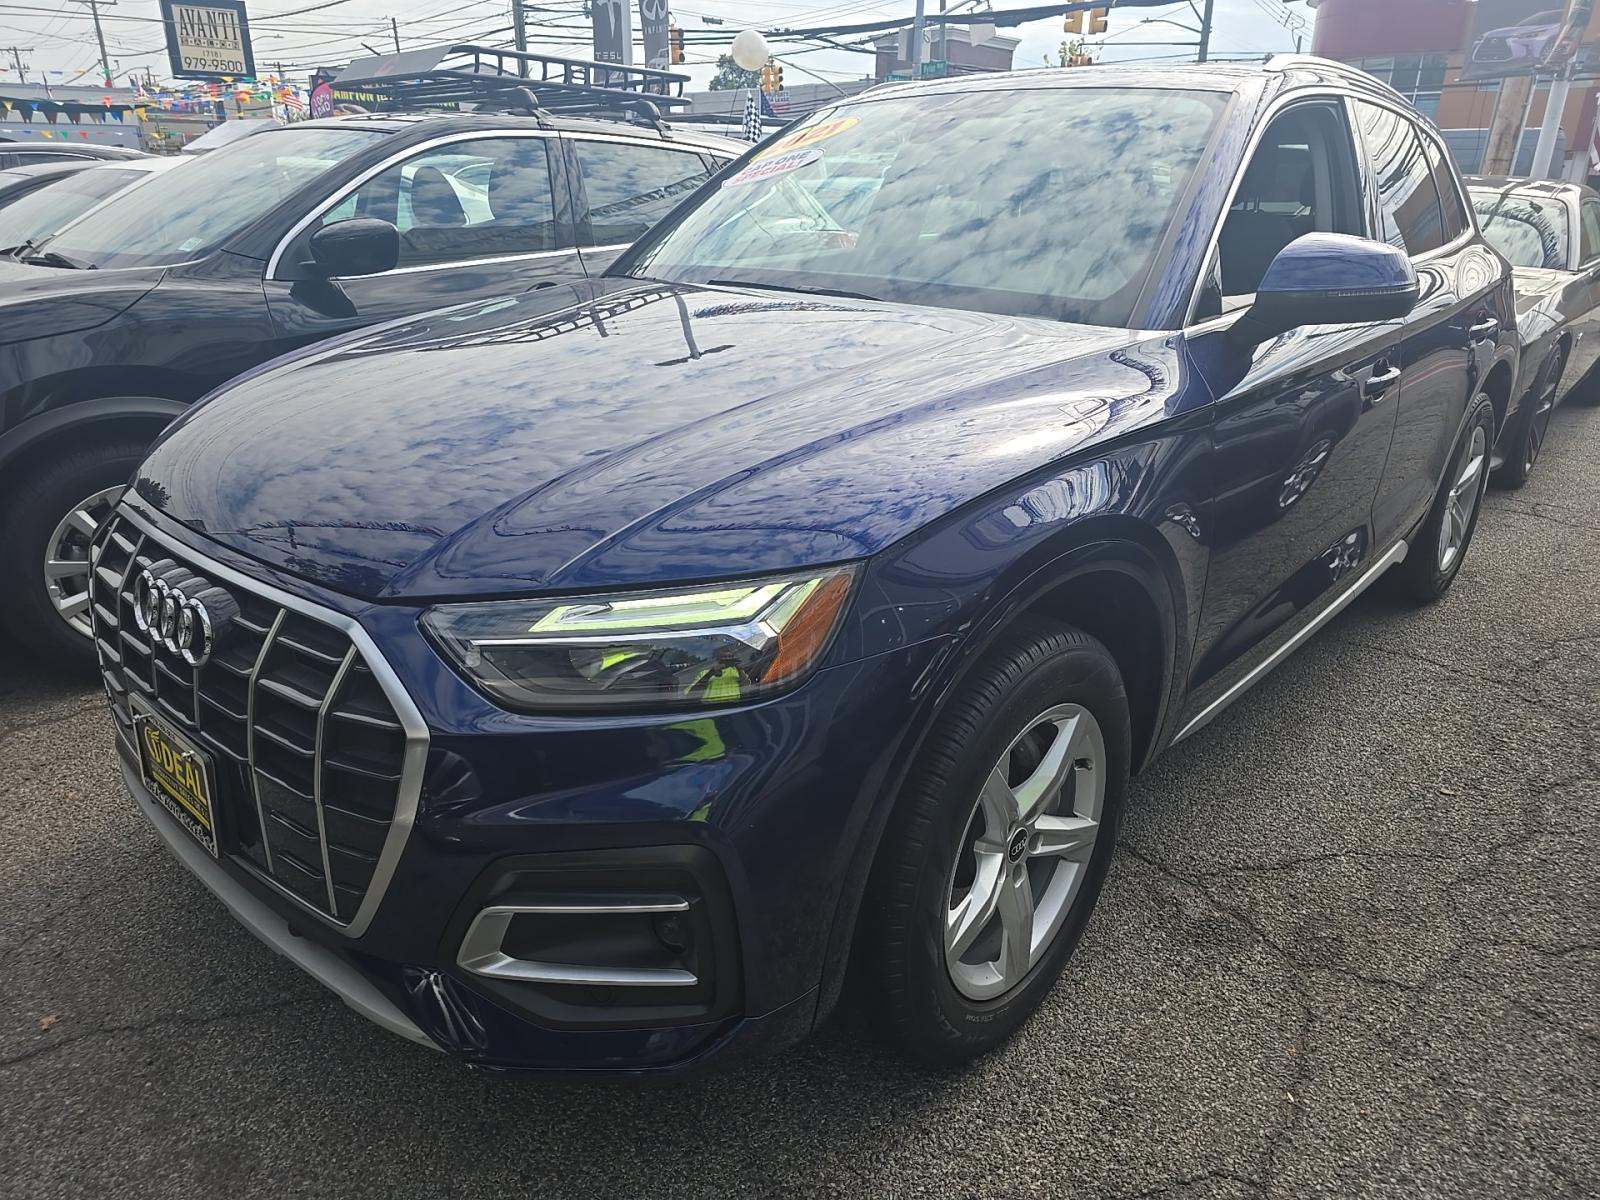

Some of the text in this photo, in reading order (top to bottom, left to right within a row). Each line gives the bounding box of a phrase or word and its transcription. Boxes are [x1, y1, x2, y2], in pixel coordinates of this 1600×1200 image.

[179, 8, 237, 40] AVANTI
[595, 51, 622, 60] TESL
[184, 56, 243, 73] 979-9500
